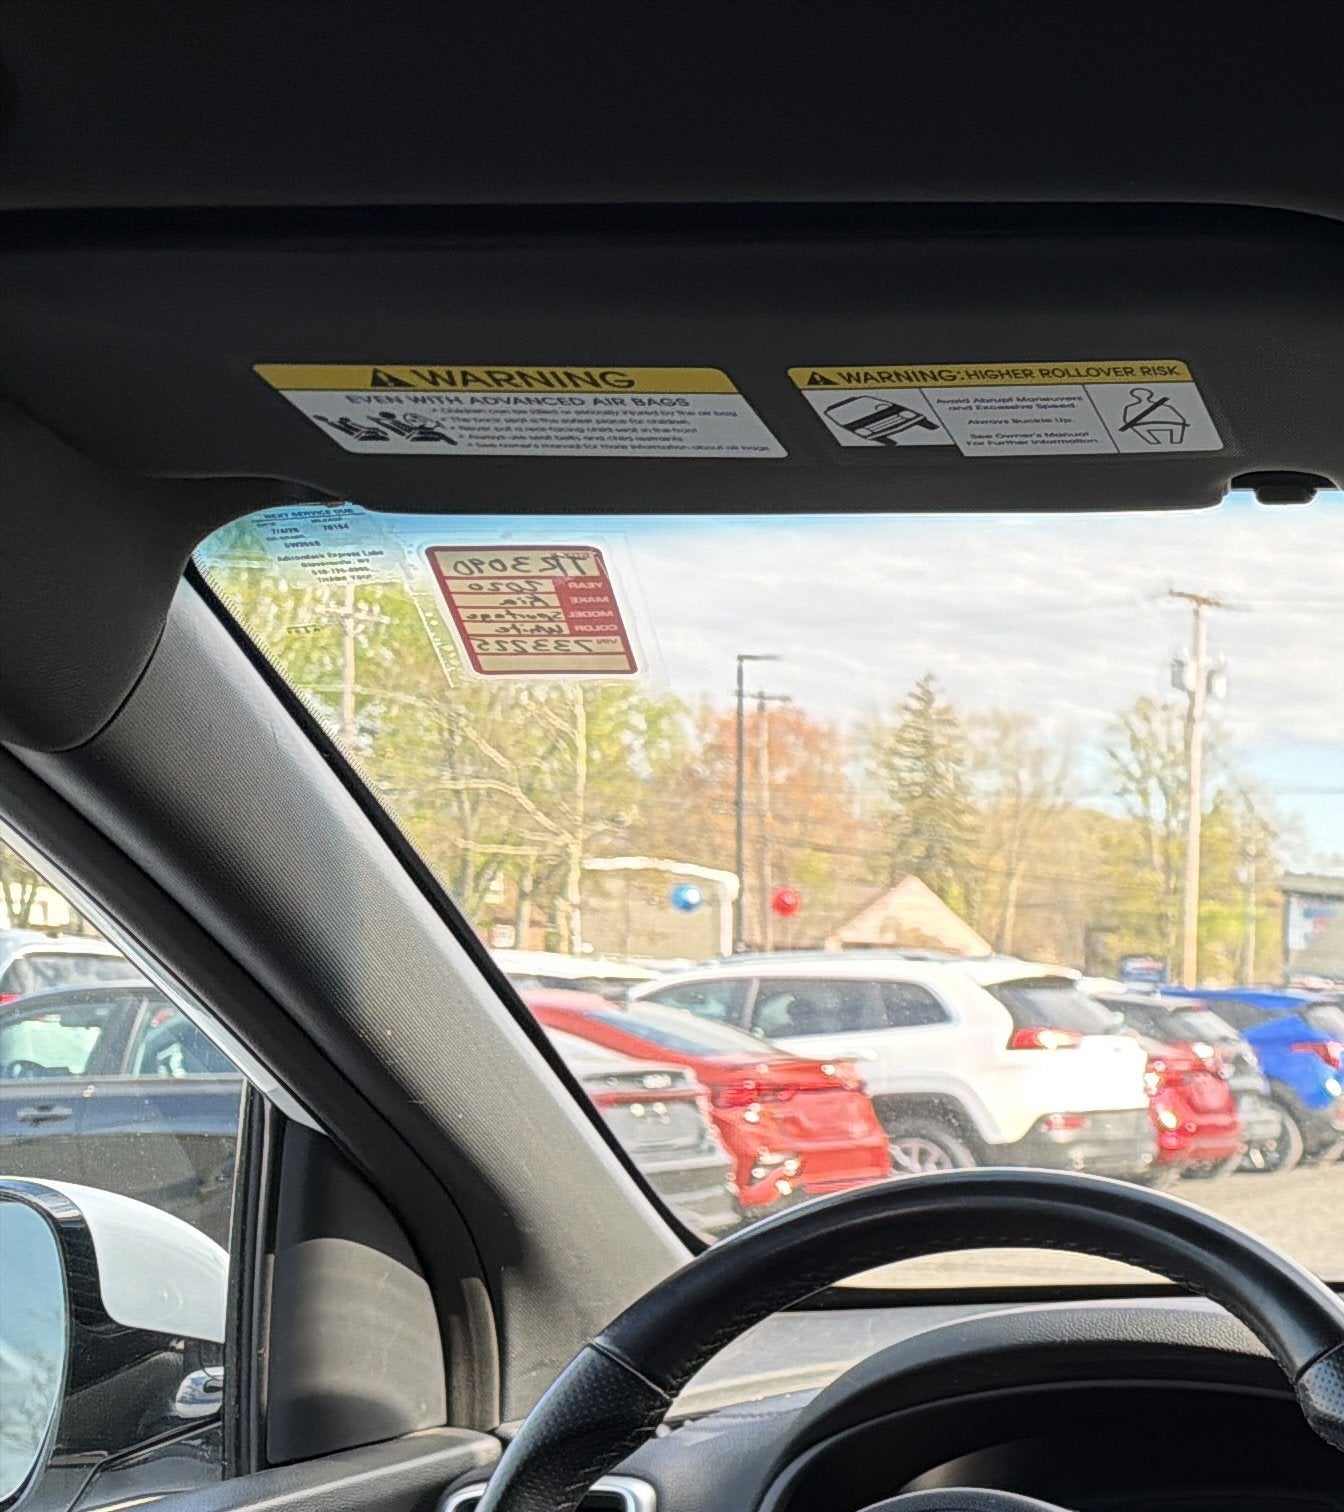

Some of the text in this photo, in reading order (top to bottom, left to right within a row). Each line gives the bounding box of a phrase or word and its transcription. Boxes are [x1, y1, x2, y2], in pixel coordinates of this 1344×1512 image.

[410, 369, 636, 389] WARNING
[837, 364, 1180, 384] WARNING: HIGHER ROLLOVER RISK
[346, 394, 691, 408] EVEN WITH ADVANCED AIR BAGS
